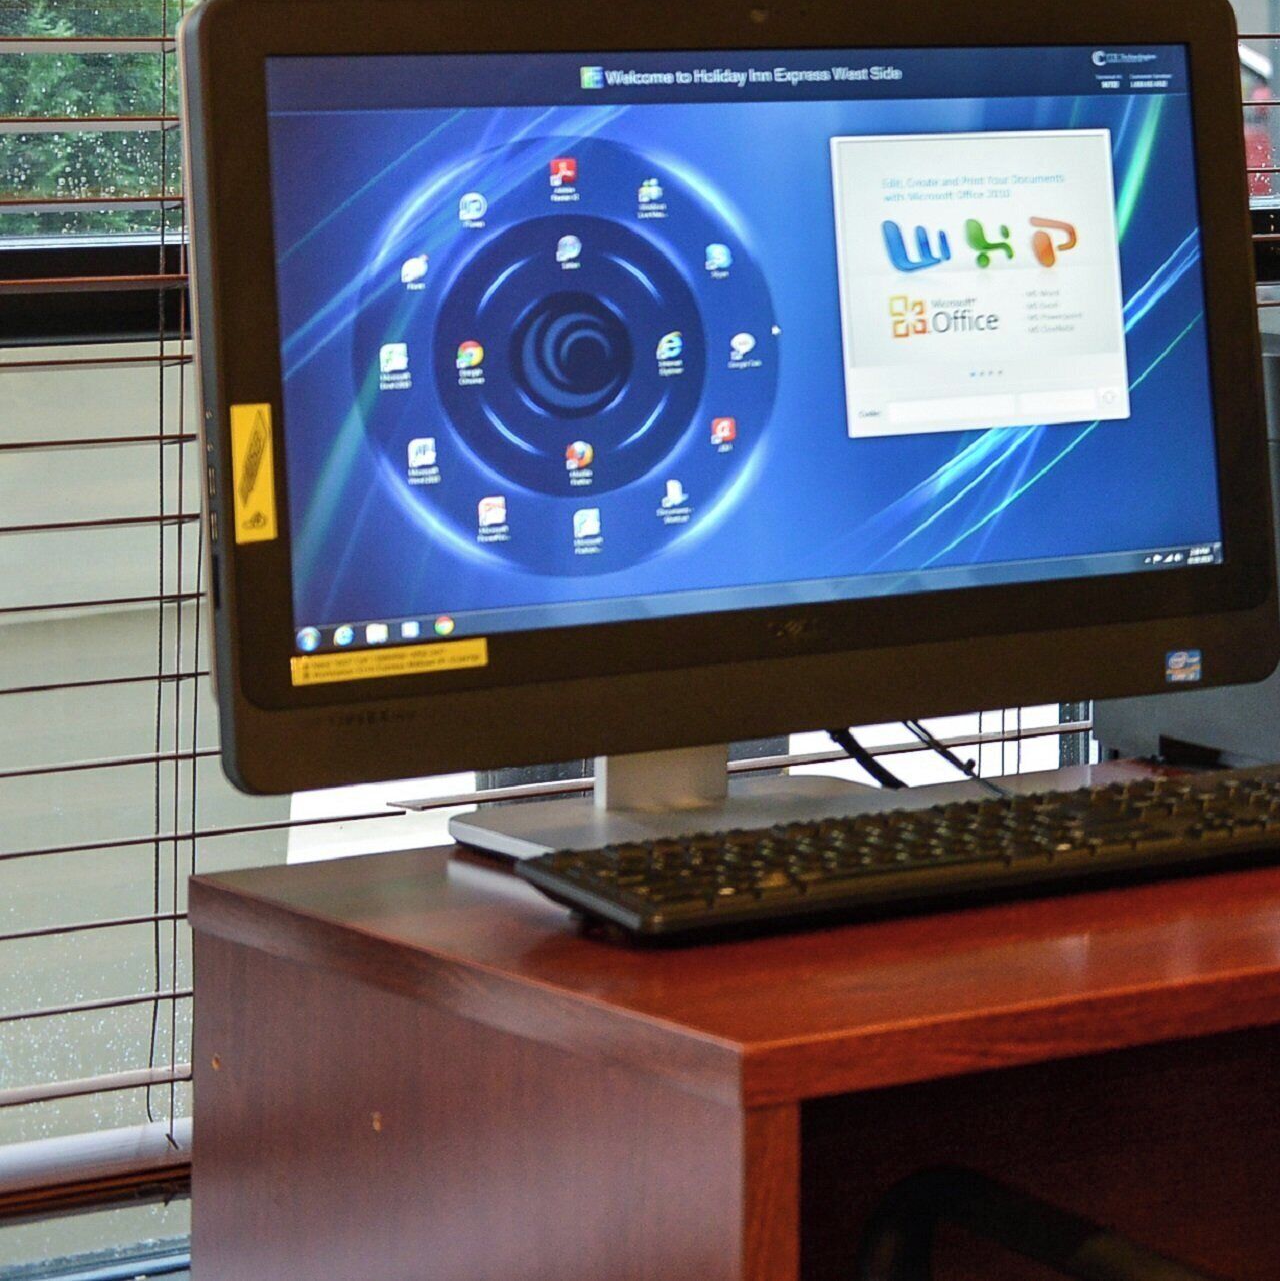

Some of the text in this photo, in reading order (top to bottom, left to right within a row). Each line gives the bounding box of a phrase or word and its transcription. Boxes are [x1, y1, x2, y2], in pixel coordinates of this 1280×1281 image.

[605, 65, 903, 87] Welcome to Holiday Inn Express West Side
[1010, 174, 1065, 185] Documents
[908, 191, 953, 201] Microsoft
[955, 189, 984, 199] Office
[932, 309, 1000, 333] Office
